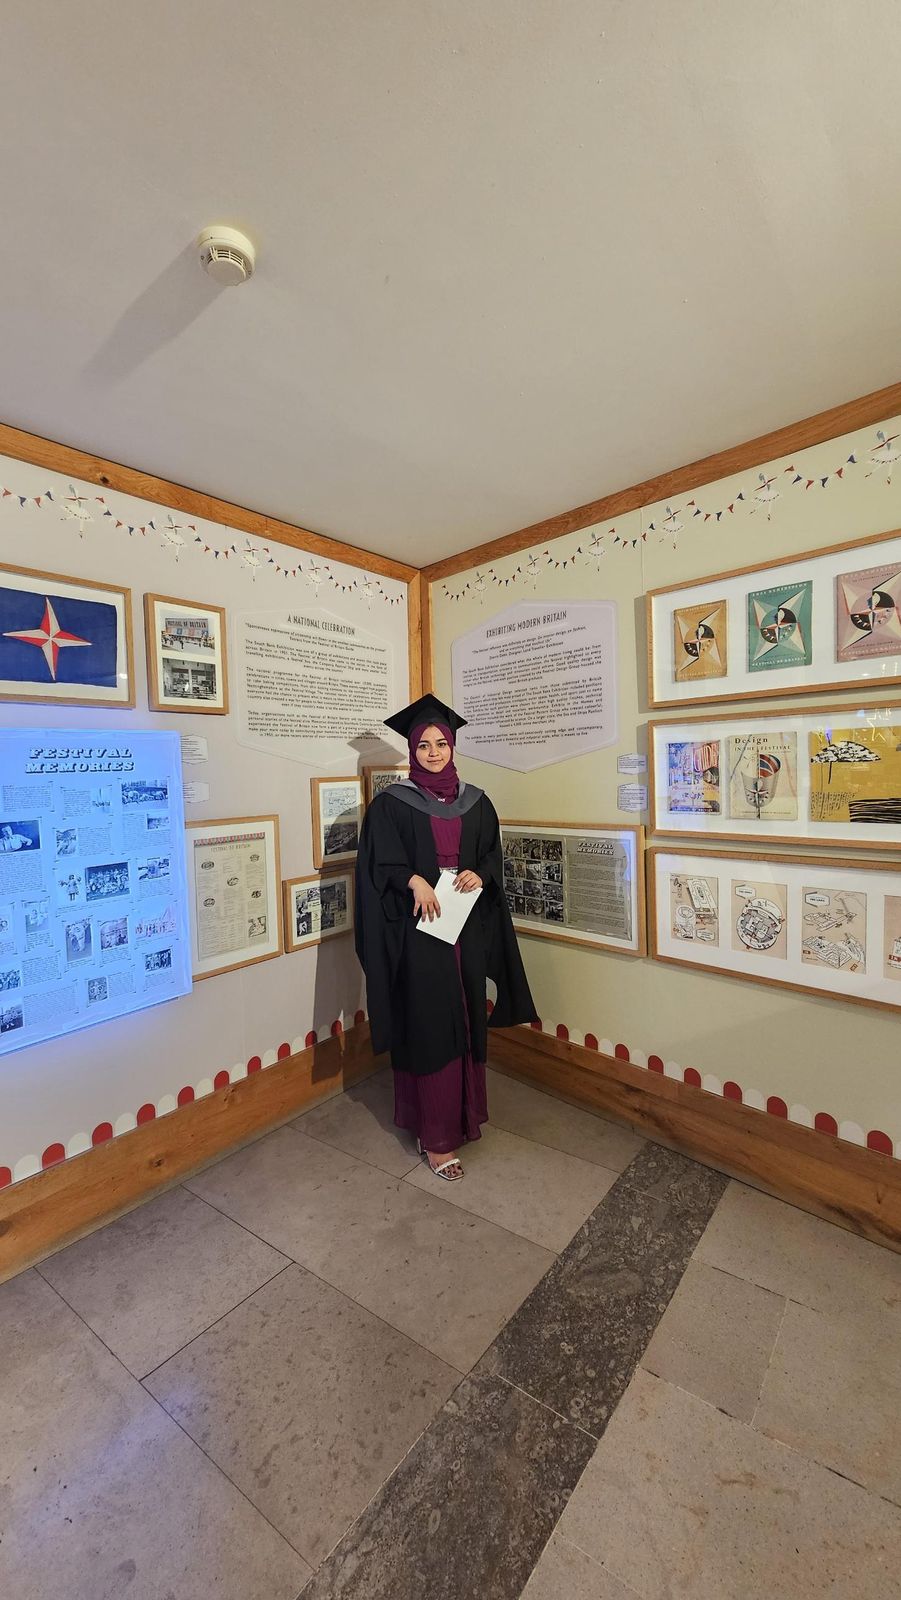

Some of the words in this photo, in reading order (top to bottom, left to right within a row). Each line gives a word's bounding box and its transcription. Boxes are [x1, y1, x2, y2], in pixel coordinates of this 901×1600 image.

[288, 614, 292, 623] A
[294, 616, 320, 628] NATIONAL
[322, 622, 355, 635] CELEBRATION
[486, 623, 516, 638] EXHIBITING
[518, 616, 540, 630] MODERN
[543, 610, 566, 624] BRITAIN
[735, 737, 768, 745] Design
[30, 748, 132, 759] FESTIVAL
[25, 762, 134, 774] MEMORIES
